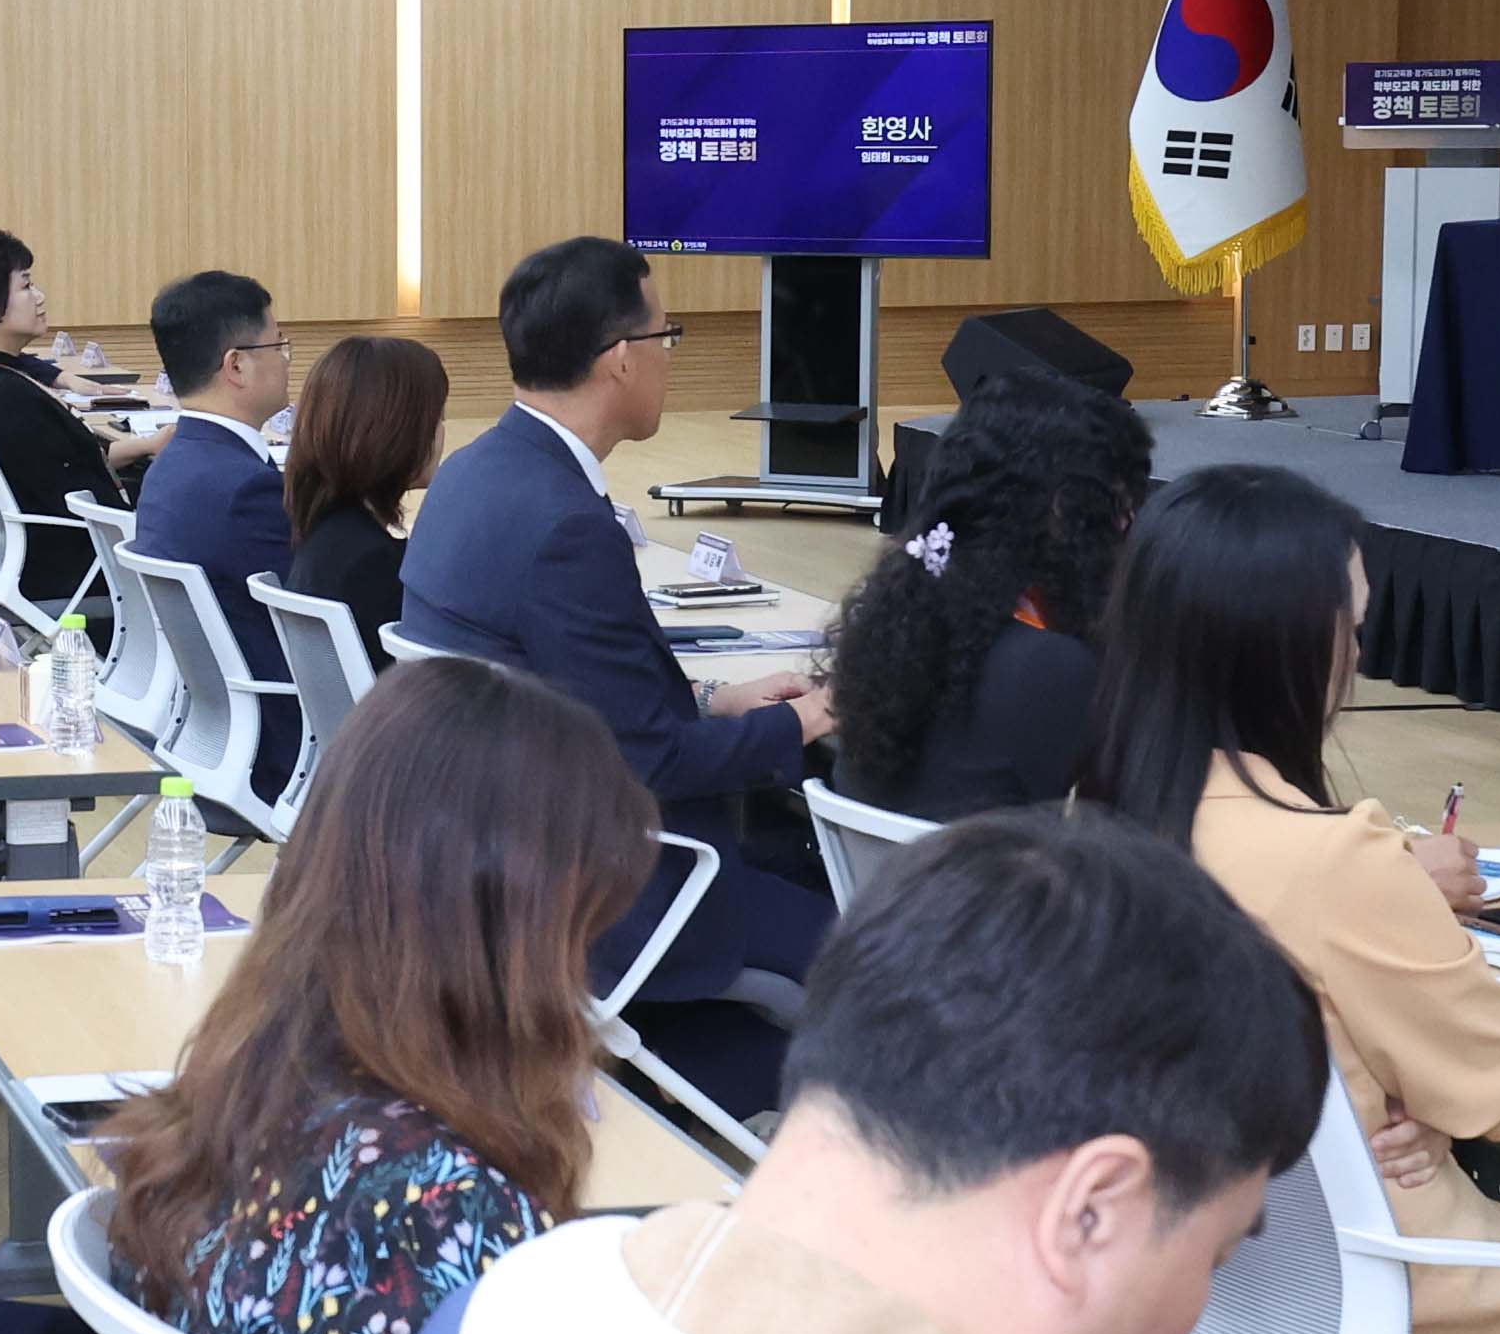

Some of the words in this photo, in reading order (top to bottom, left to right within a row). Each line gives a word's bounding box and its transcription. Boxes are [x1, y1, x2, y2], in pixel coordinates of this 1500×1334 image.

[1373, 80, 1420, 92] 학부모교육
[1422, 80, 1459, 92] 제도화를
[1462, 80, 1481, 92] 위한
[1372, 95, 1413, 119] 정책
[1418, 95, 1480, 119] 토론회
[862, 116, 932, 141] 환영사
[660, 141, 697, 161] 정책
[701, 141, 756, 161] 토론회
